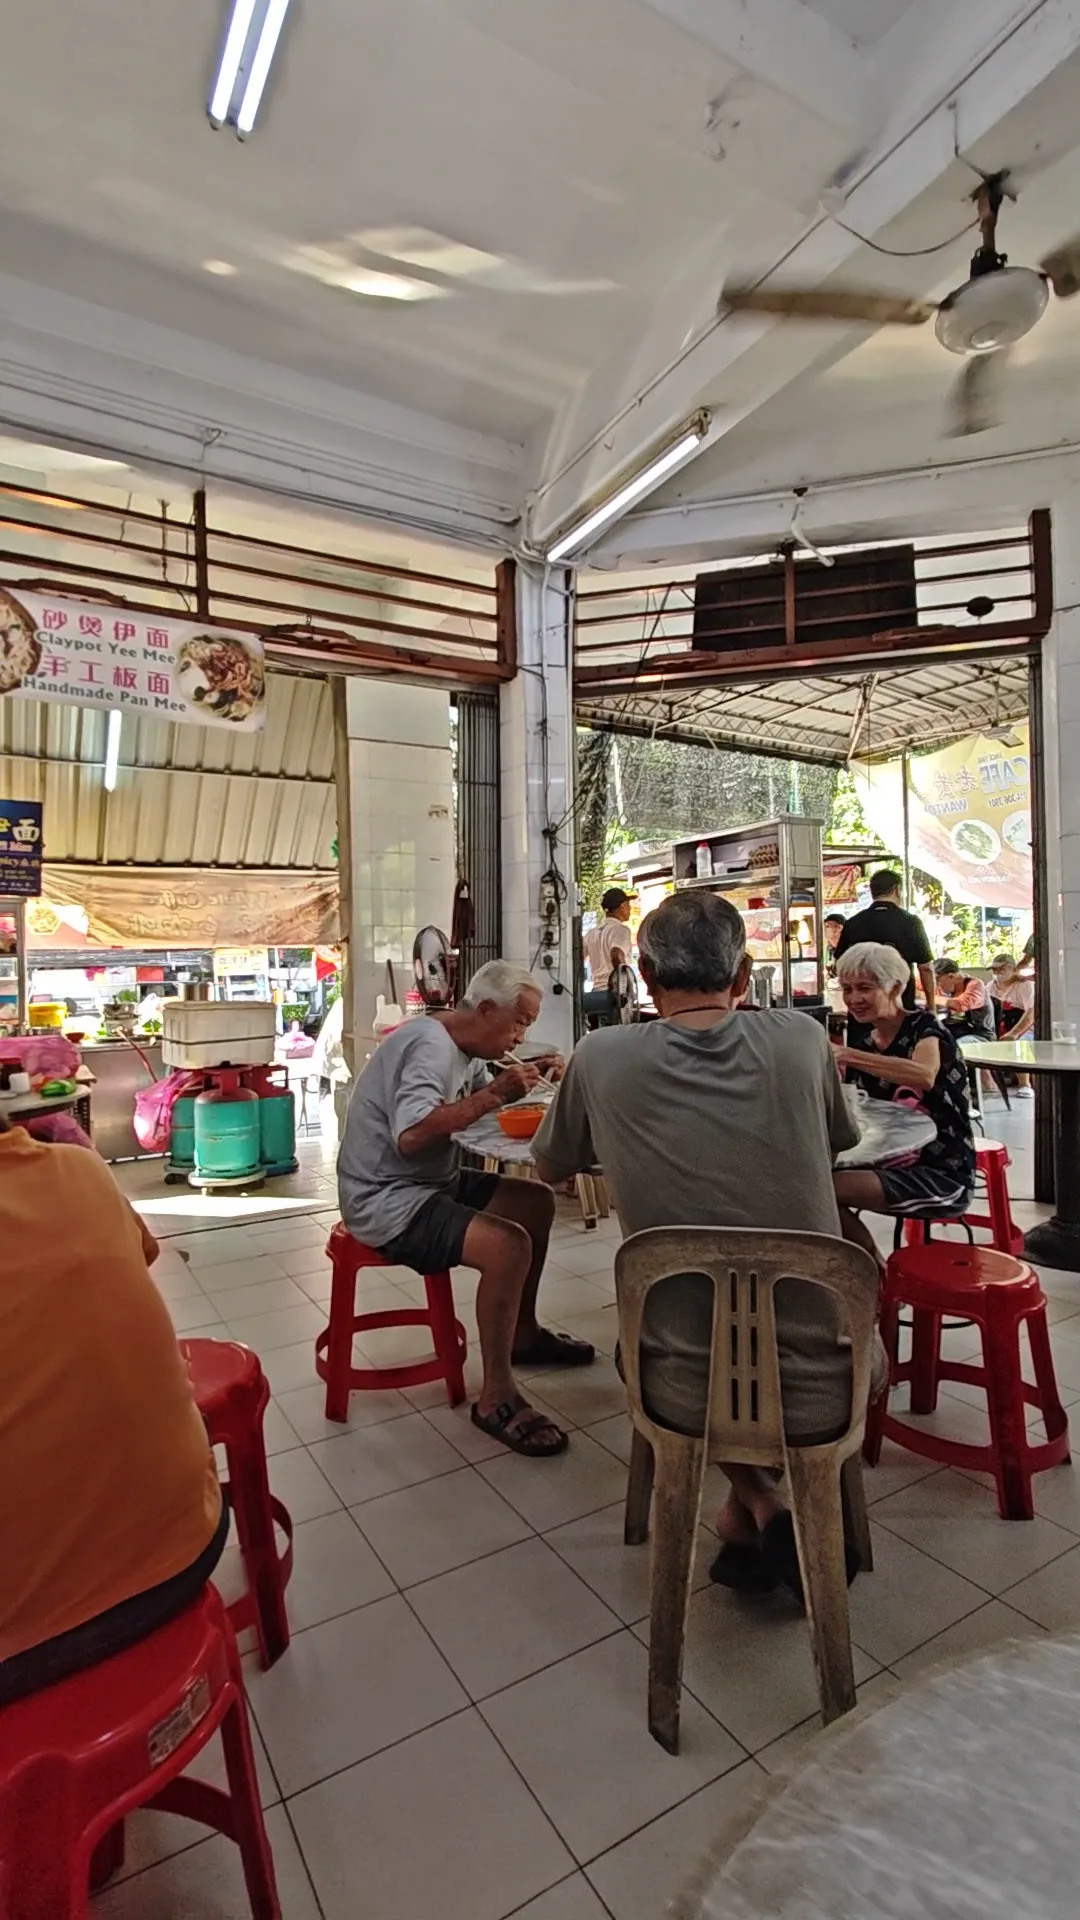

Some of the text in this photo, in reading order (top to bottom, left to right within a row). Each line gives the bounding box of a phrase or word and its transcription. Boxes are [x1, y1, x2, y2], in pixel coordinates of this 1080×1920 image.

[36, 630, 176, 664] Claypot Yee Mee
[23, 676, 187, 713] Handmade Pan Mee
